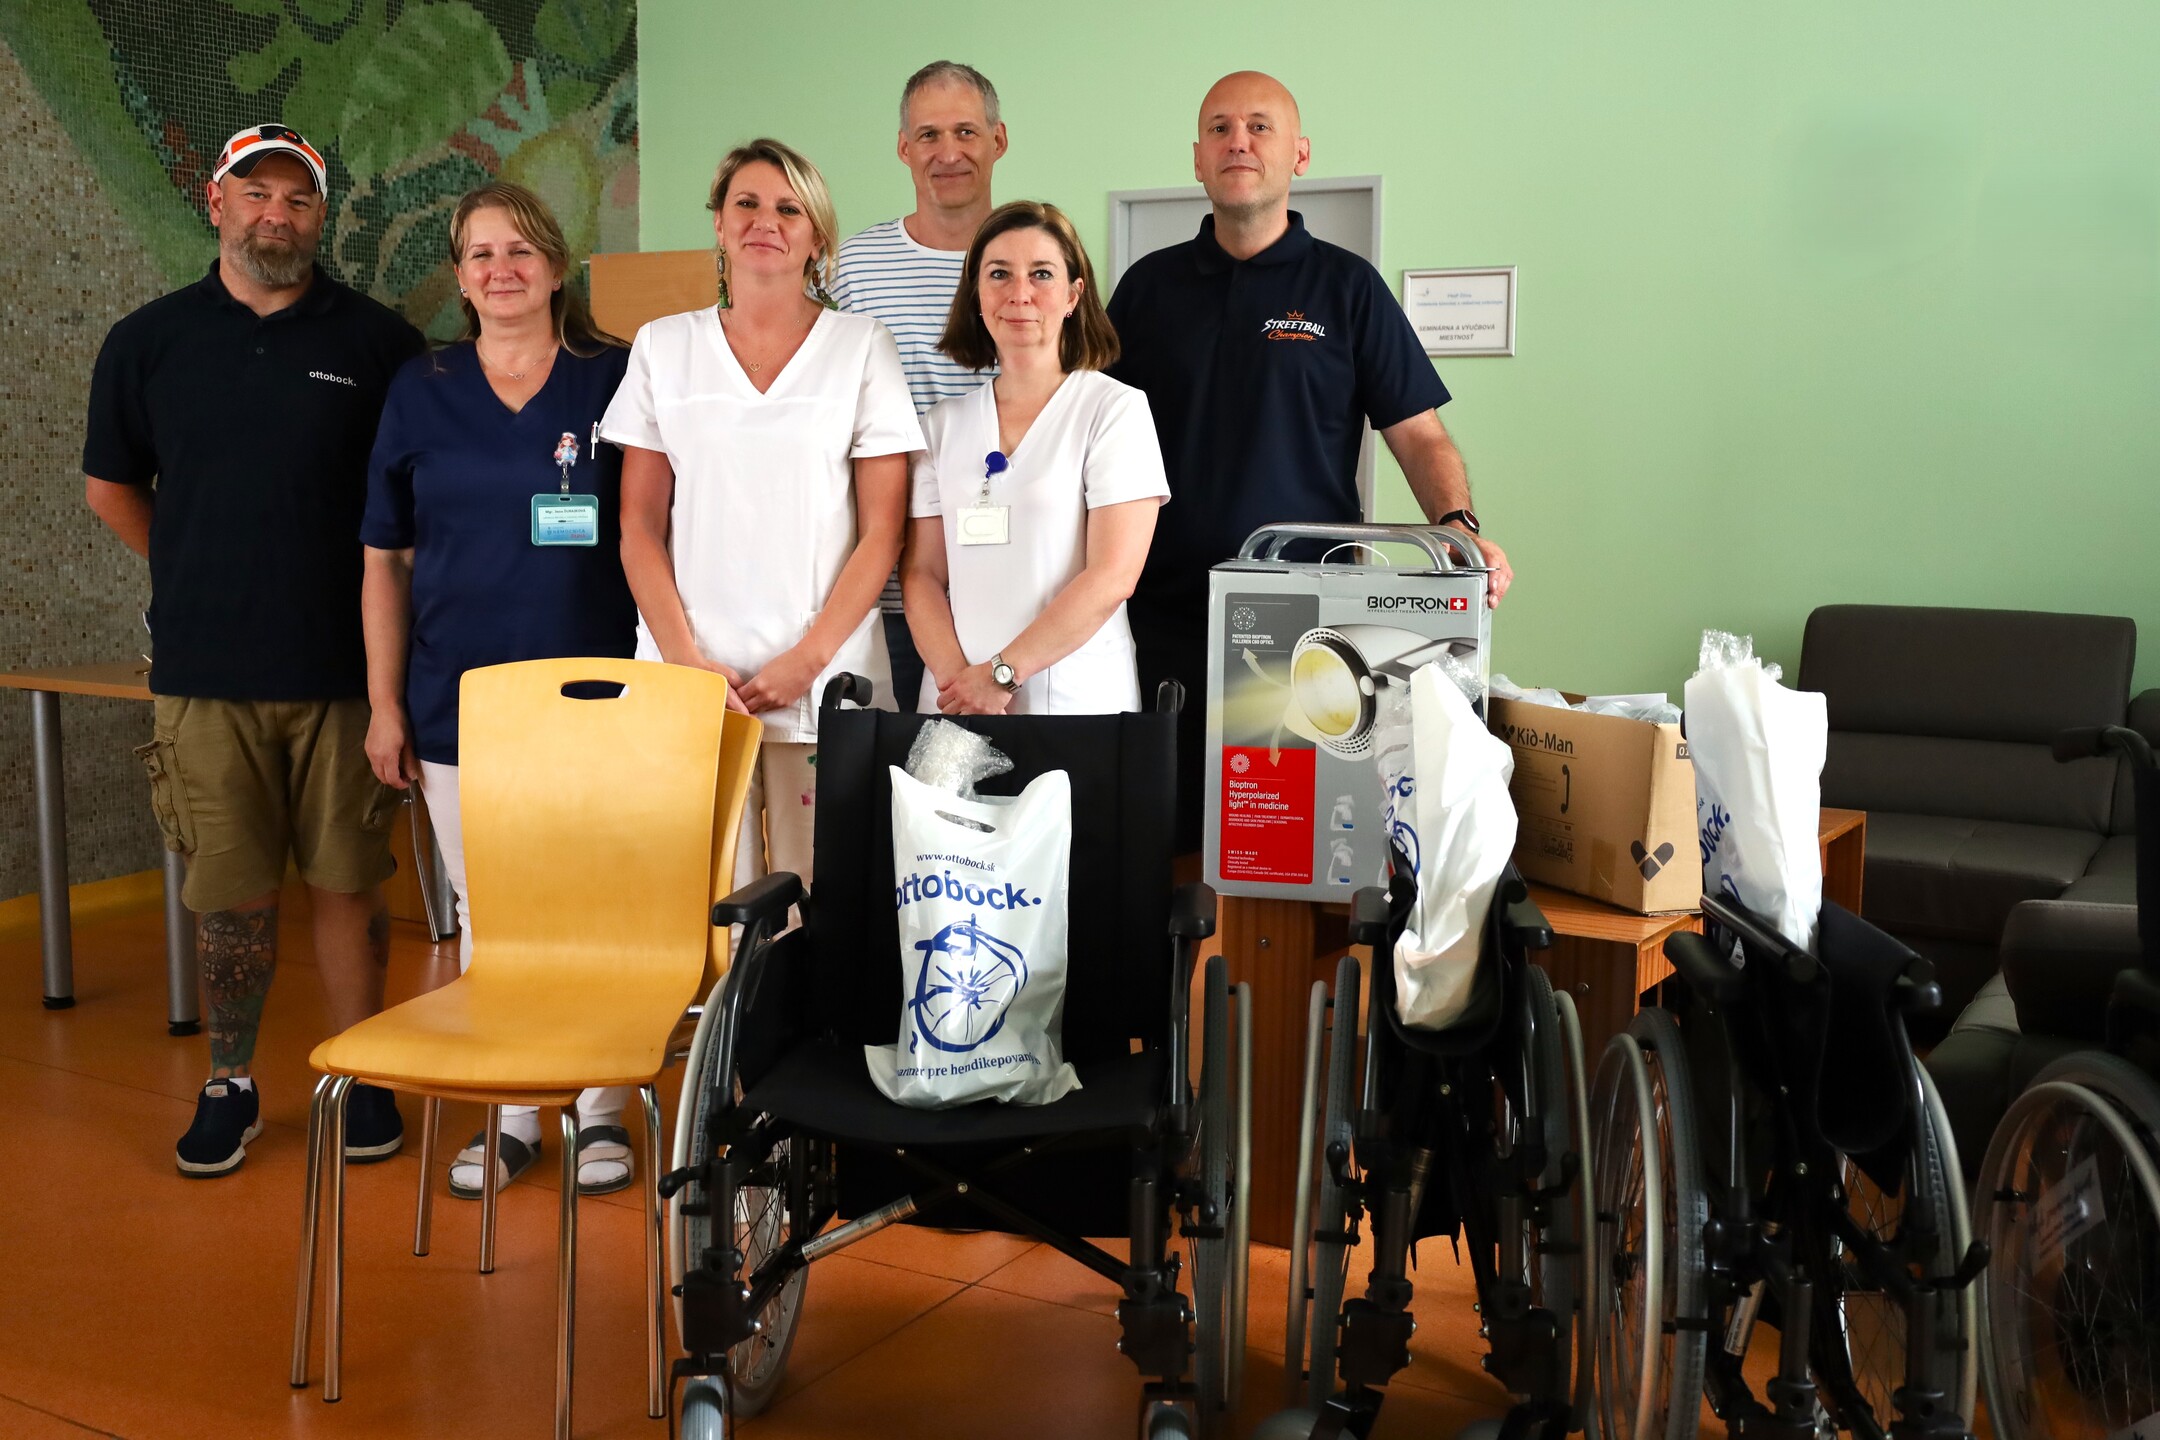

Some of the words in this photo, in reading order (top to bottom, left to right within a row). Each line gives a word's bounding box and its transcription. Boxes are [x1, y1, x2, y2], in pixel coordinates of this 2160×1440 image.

[1261, 318, 1326, 337] STREETBALL
[309, 370, 357, 387] ottobock.
[1367, 596, 1449, 613] BIOPTRON
[1229, 780, 1258, 790] Bioptron
[1229, 790, 1280, 800] Hyperpolarized
[1249, 801, 1257, 809] in
[1257, 801, 1289, 811] medicine
[916, 853, 996, 872] www.ottobock.sk
[927, 1067, 948, 1080] pre
